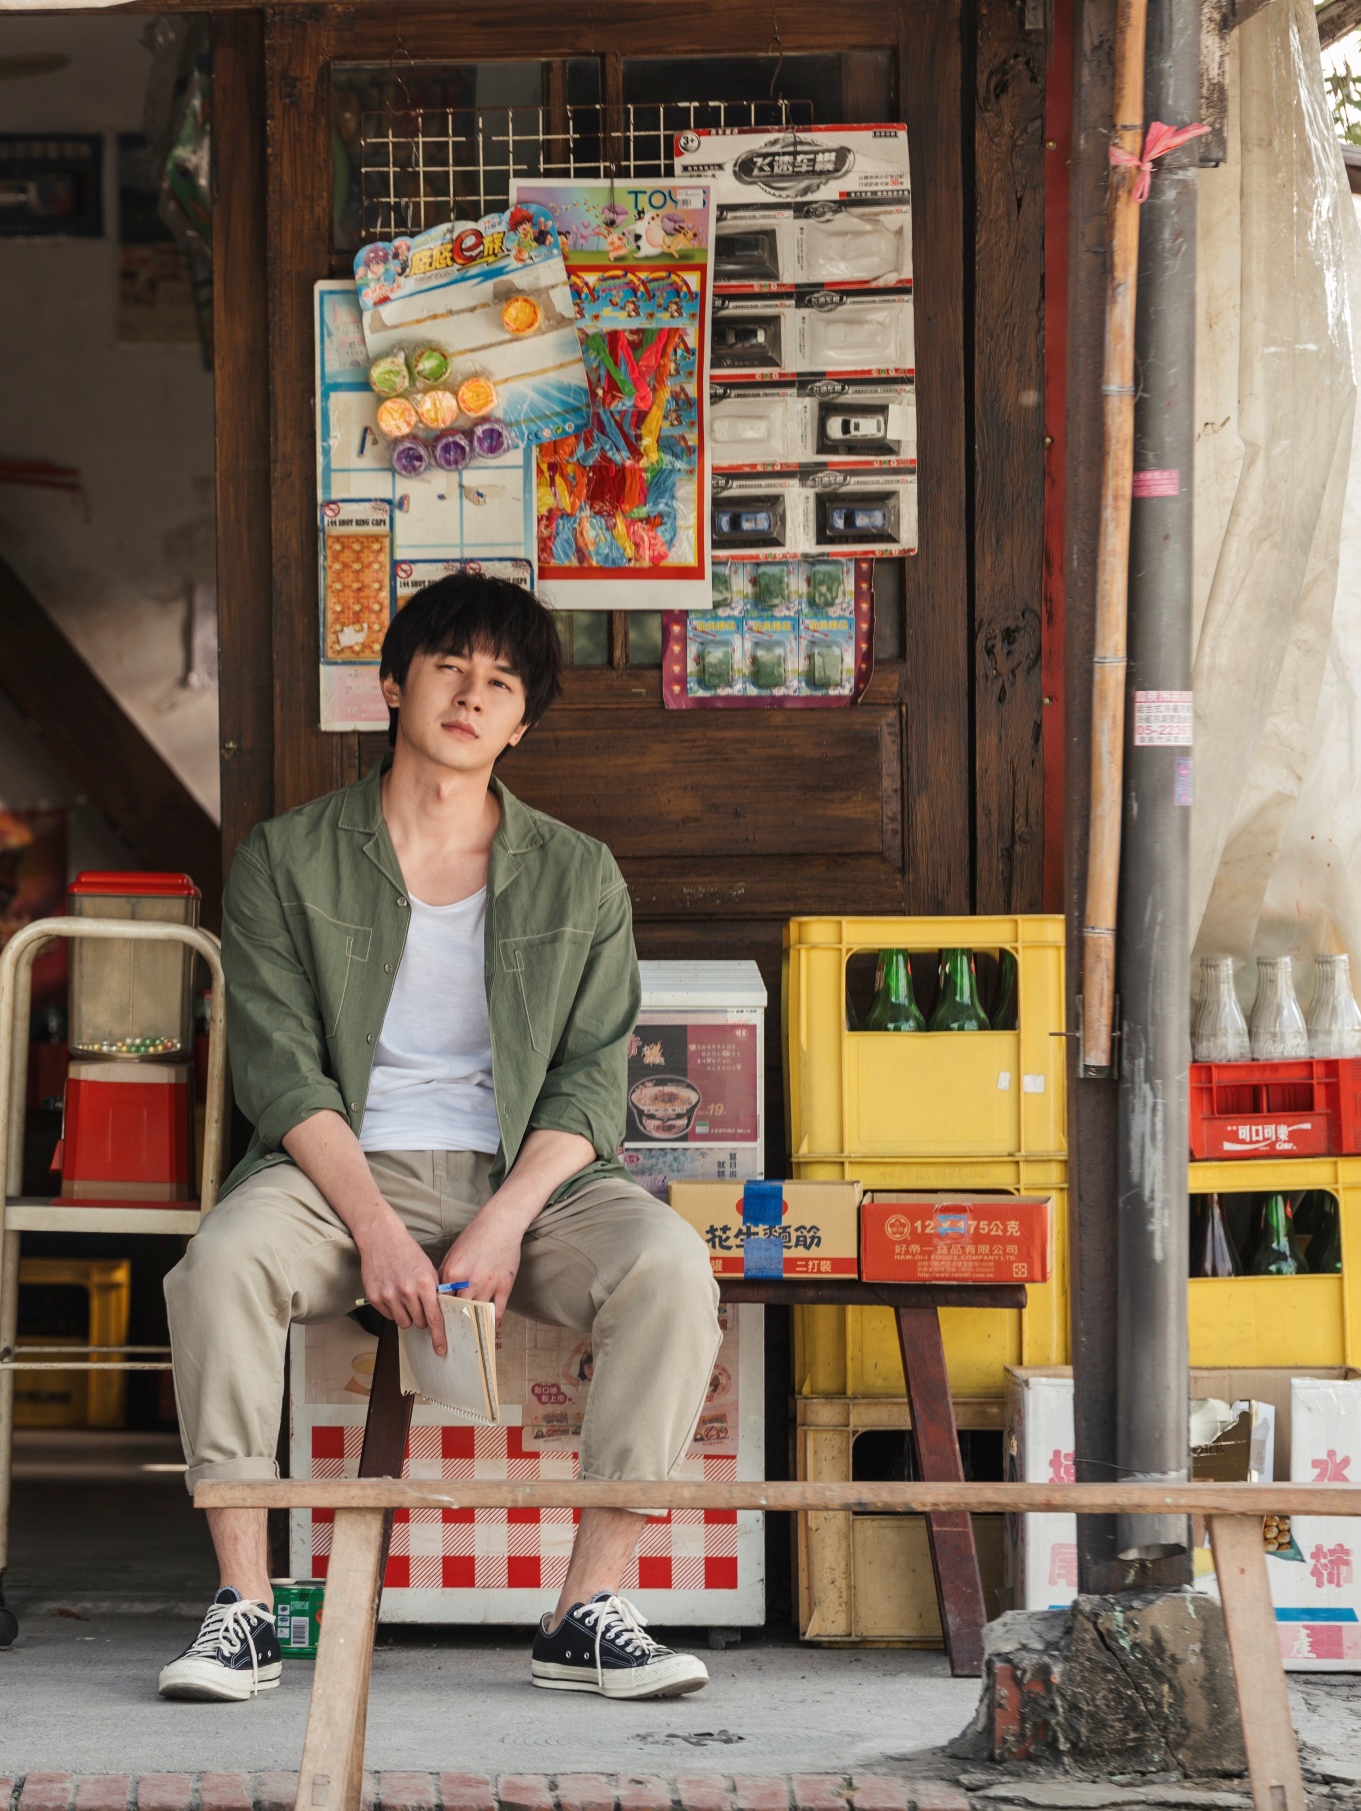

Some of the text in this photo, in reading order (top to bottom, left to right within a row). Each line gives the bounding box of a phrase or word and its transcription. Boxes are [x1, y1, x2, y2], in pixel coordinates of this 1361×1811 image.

[752, 151, 837, 176] 飞速车模
[627, 189, 707, 211] TO
[339, 519, 353, 527] SHOT
[355, 519, 370, 527] RING
[371, 518, 387, 527] CAPS
[707, 1102, 724, 1116] 19
[1238, 1124, 1289, 1142] 可口可樂
[705, 1224, 822, 1251] 花生麵筋
[894, 1243, 1019, 1256] 好帝一食品有限公司
[795, 1259, 833, 1273] 二打裝
